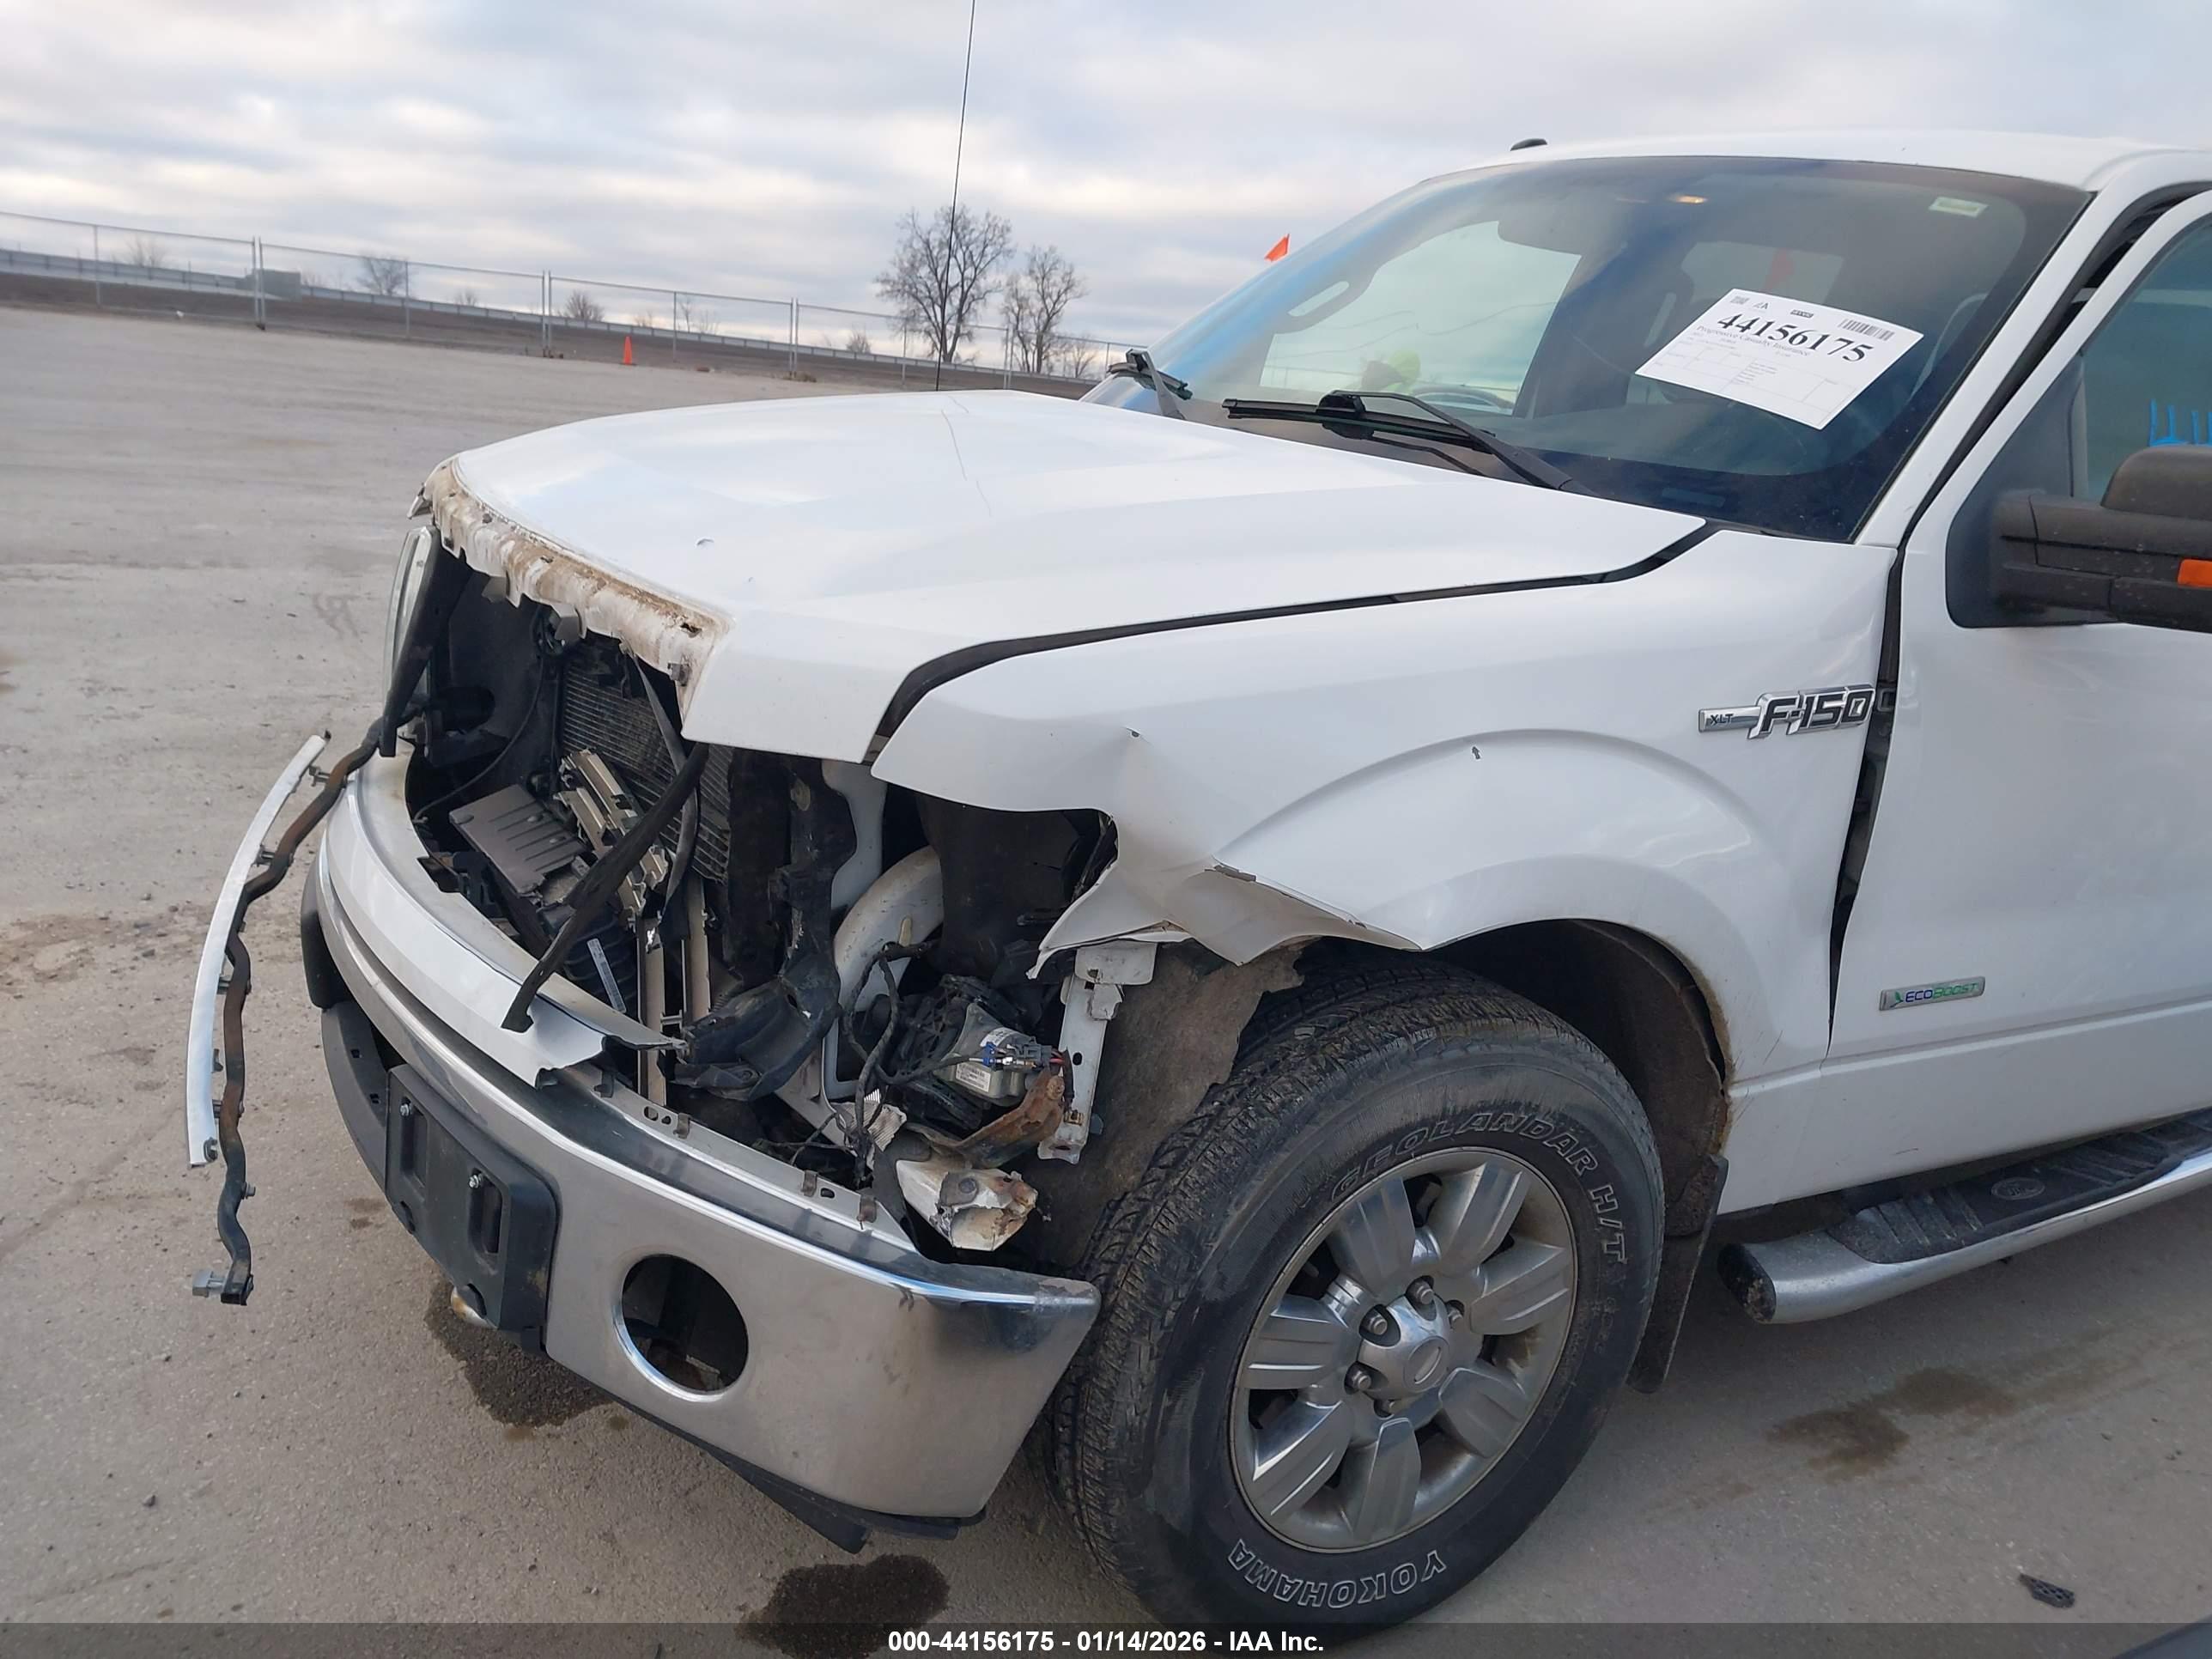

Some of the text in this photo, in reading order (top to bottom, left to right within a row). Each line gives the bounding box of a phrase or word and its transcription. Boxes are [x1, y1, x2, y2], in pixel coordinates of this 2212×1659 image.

[1717, 313, 1874, 362] 44156175
[1710, 685, 1876, 739] XLT F-150
[1905, 982, 1978, 1003] ECOBOOST
[1331, 1113, 1628, 1265] GEOLANDAR H/T
[1227, 1539, 1447, 1609] YOKOHAMA
